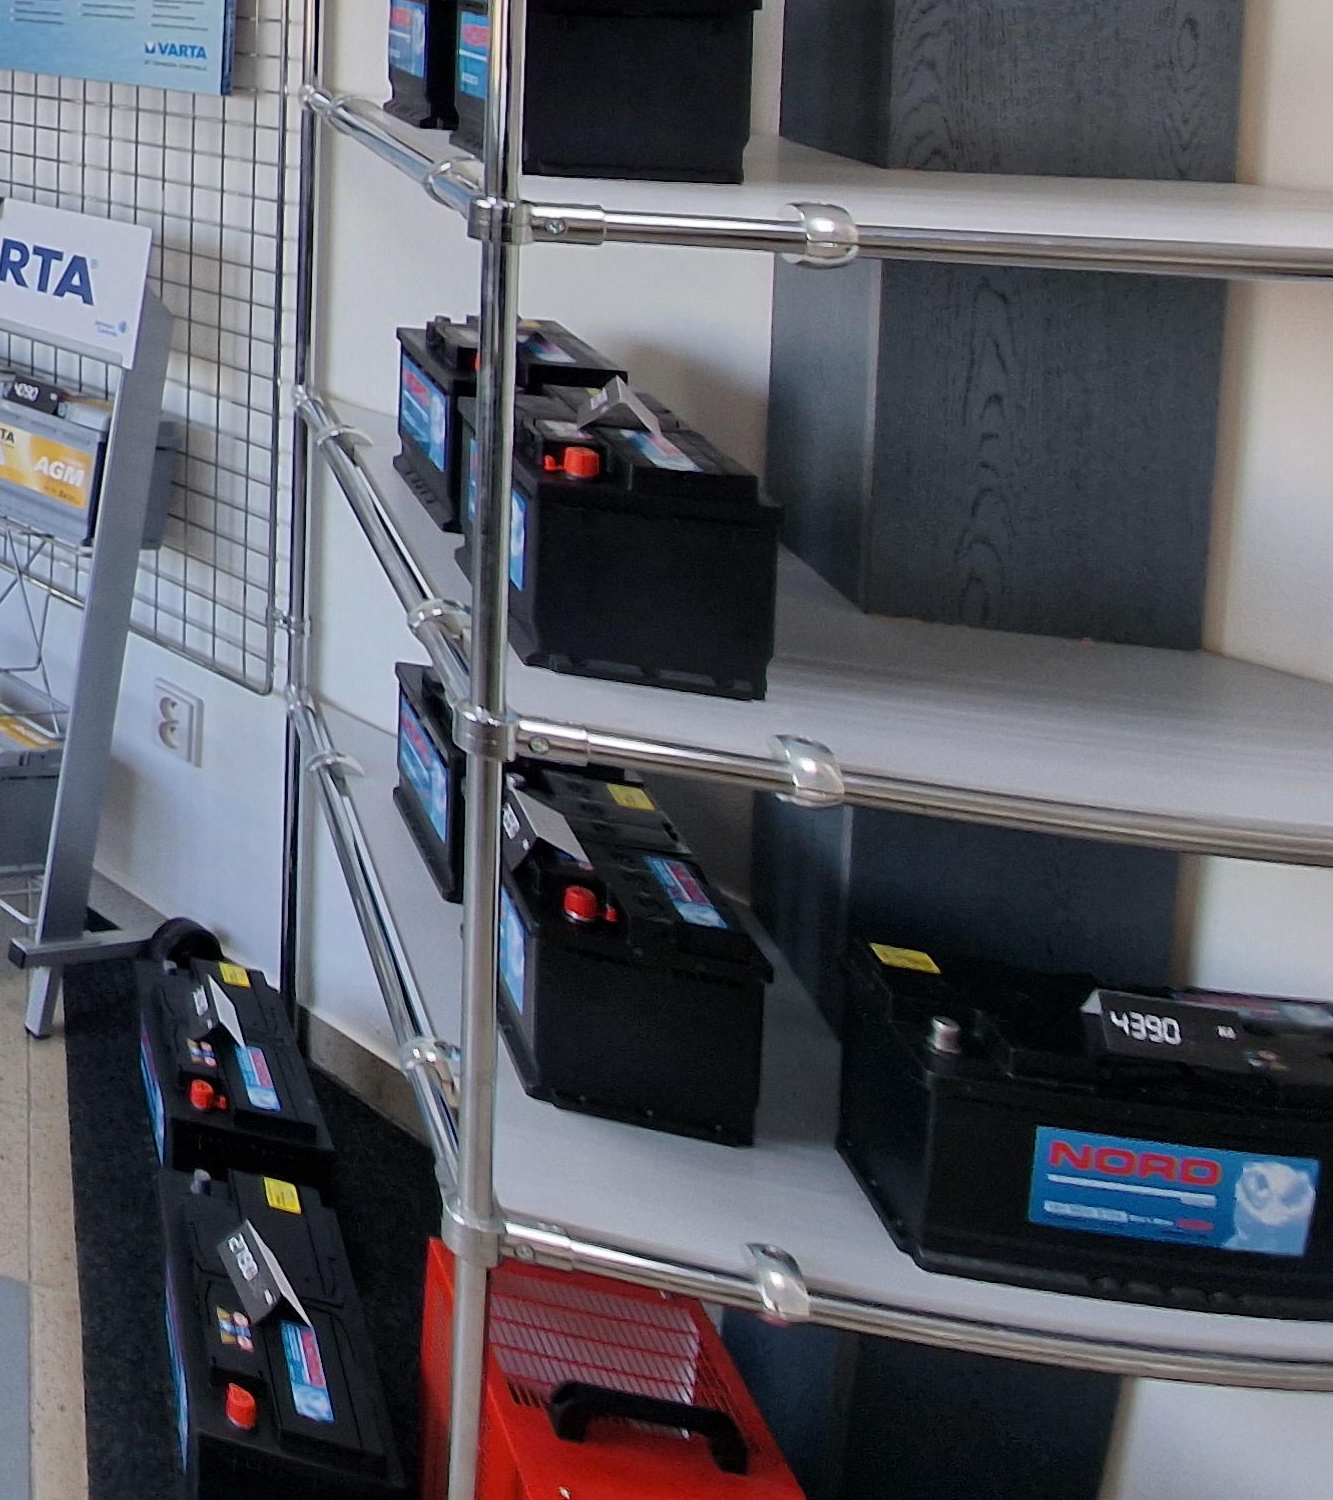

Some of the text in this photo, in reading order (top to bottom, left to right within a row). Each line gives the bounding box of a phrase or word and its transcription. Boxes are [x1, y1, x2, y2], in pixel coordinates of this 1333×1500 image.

[157, 42, 208, 60] VARTA
[34, 455, 86, 489] AGM
[1108, 1008, 1182, 1047] 4390
[1048, 1139, 1223, 1187] NORD
